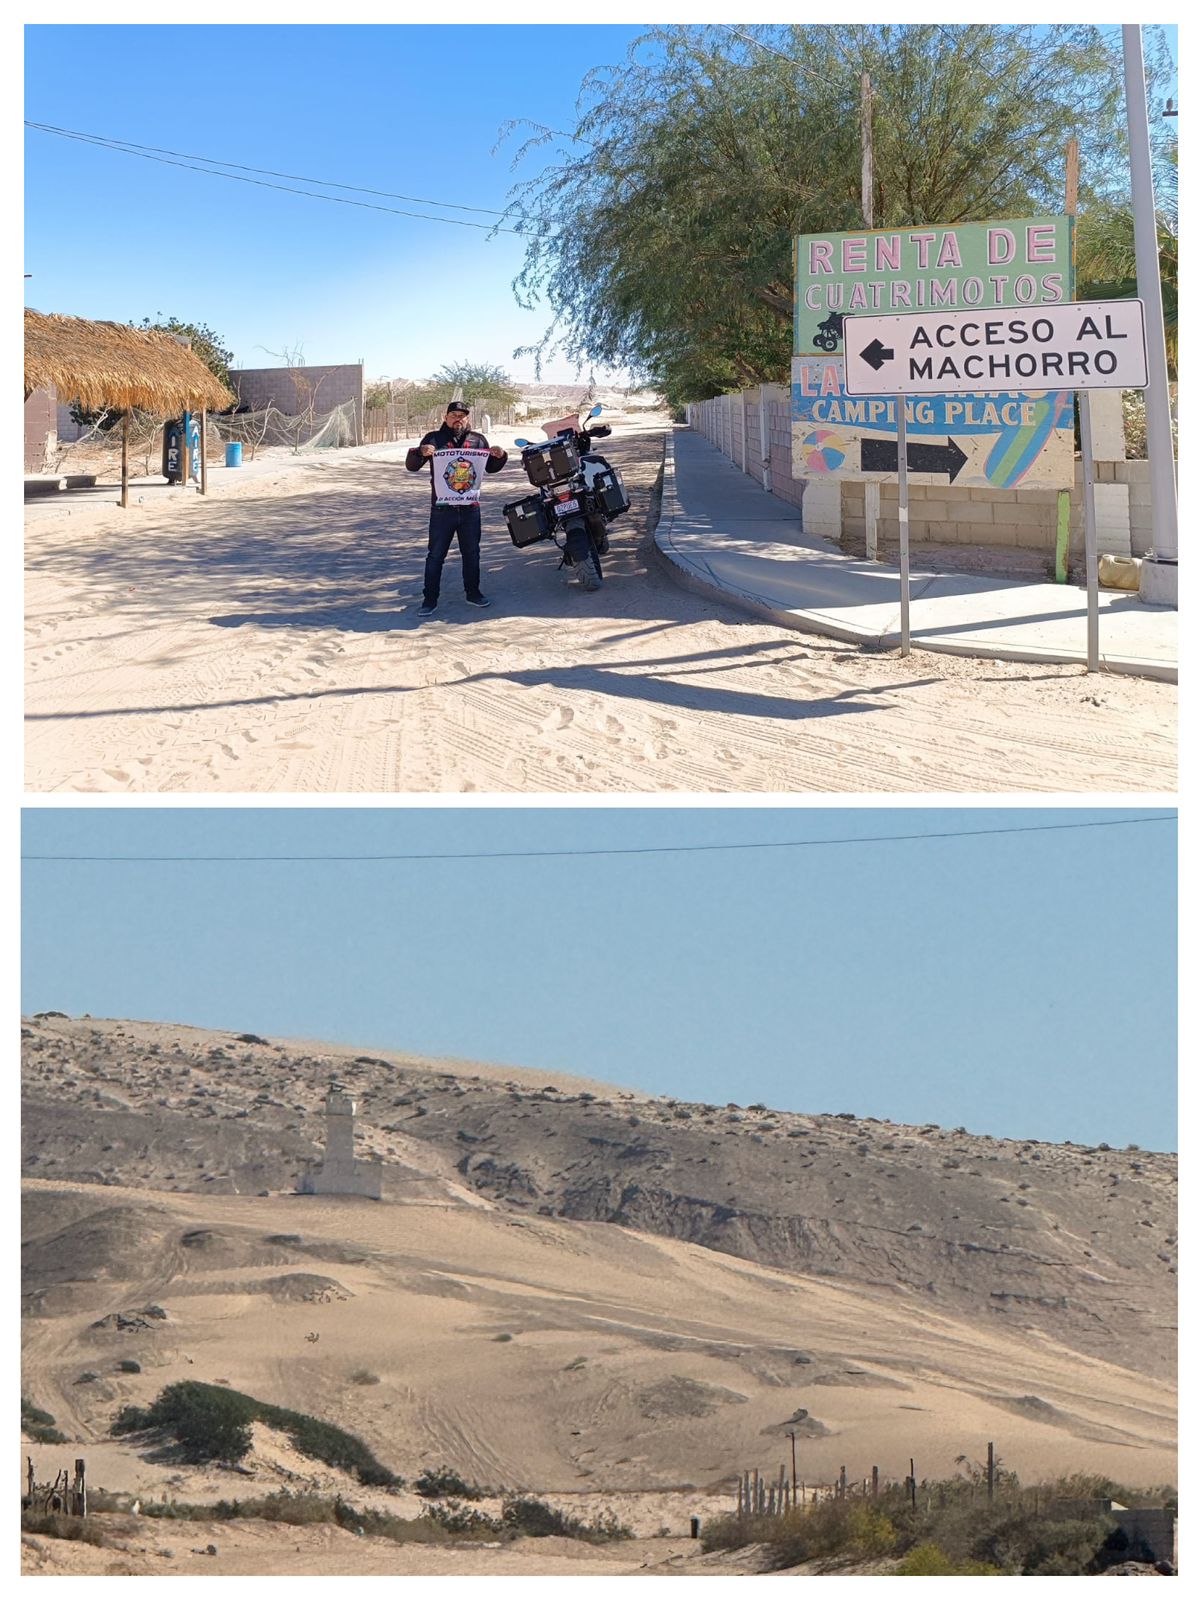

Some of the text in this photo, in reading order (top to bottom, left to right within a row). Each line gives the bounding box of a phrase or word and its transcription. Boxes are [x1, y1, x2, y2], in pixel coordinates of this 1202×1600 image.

[808, 225, 1056, 275] RENTA DE
[805, 273, 1063, 310] CUATRIMOTOS
[909, 314, 1128, 350] ACCESO AL
[909, 349, 1118, 381] MACHORRO
[811, 399, 1037, 427] CAMPING PLACE
[433, 450, 489, 458] MOTOTURISMO
